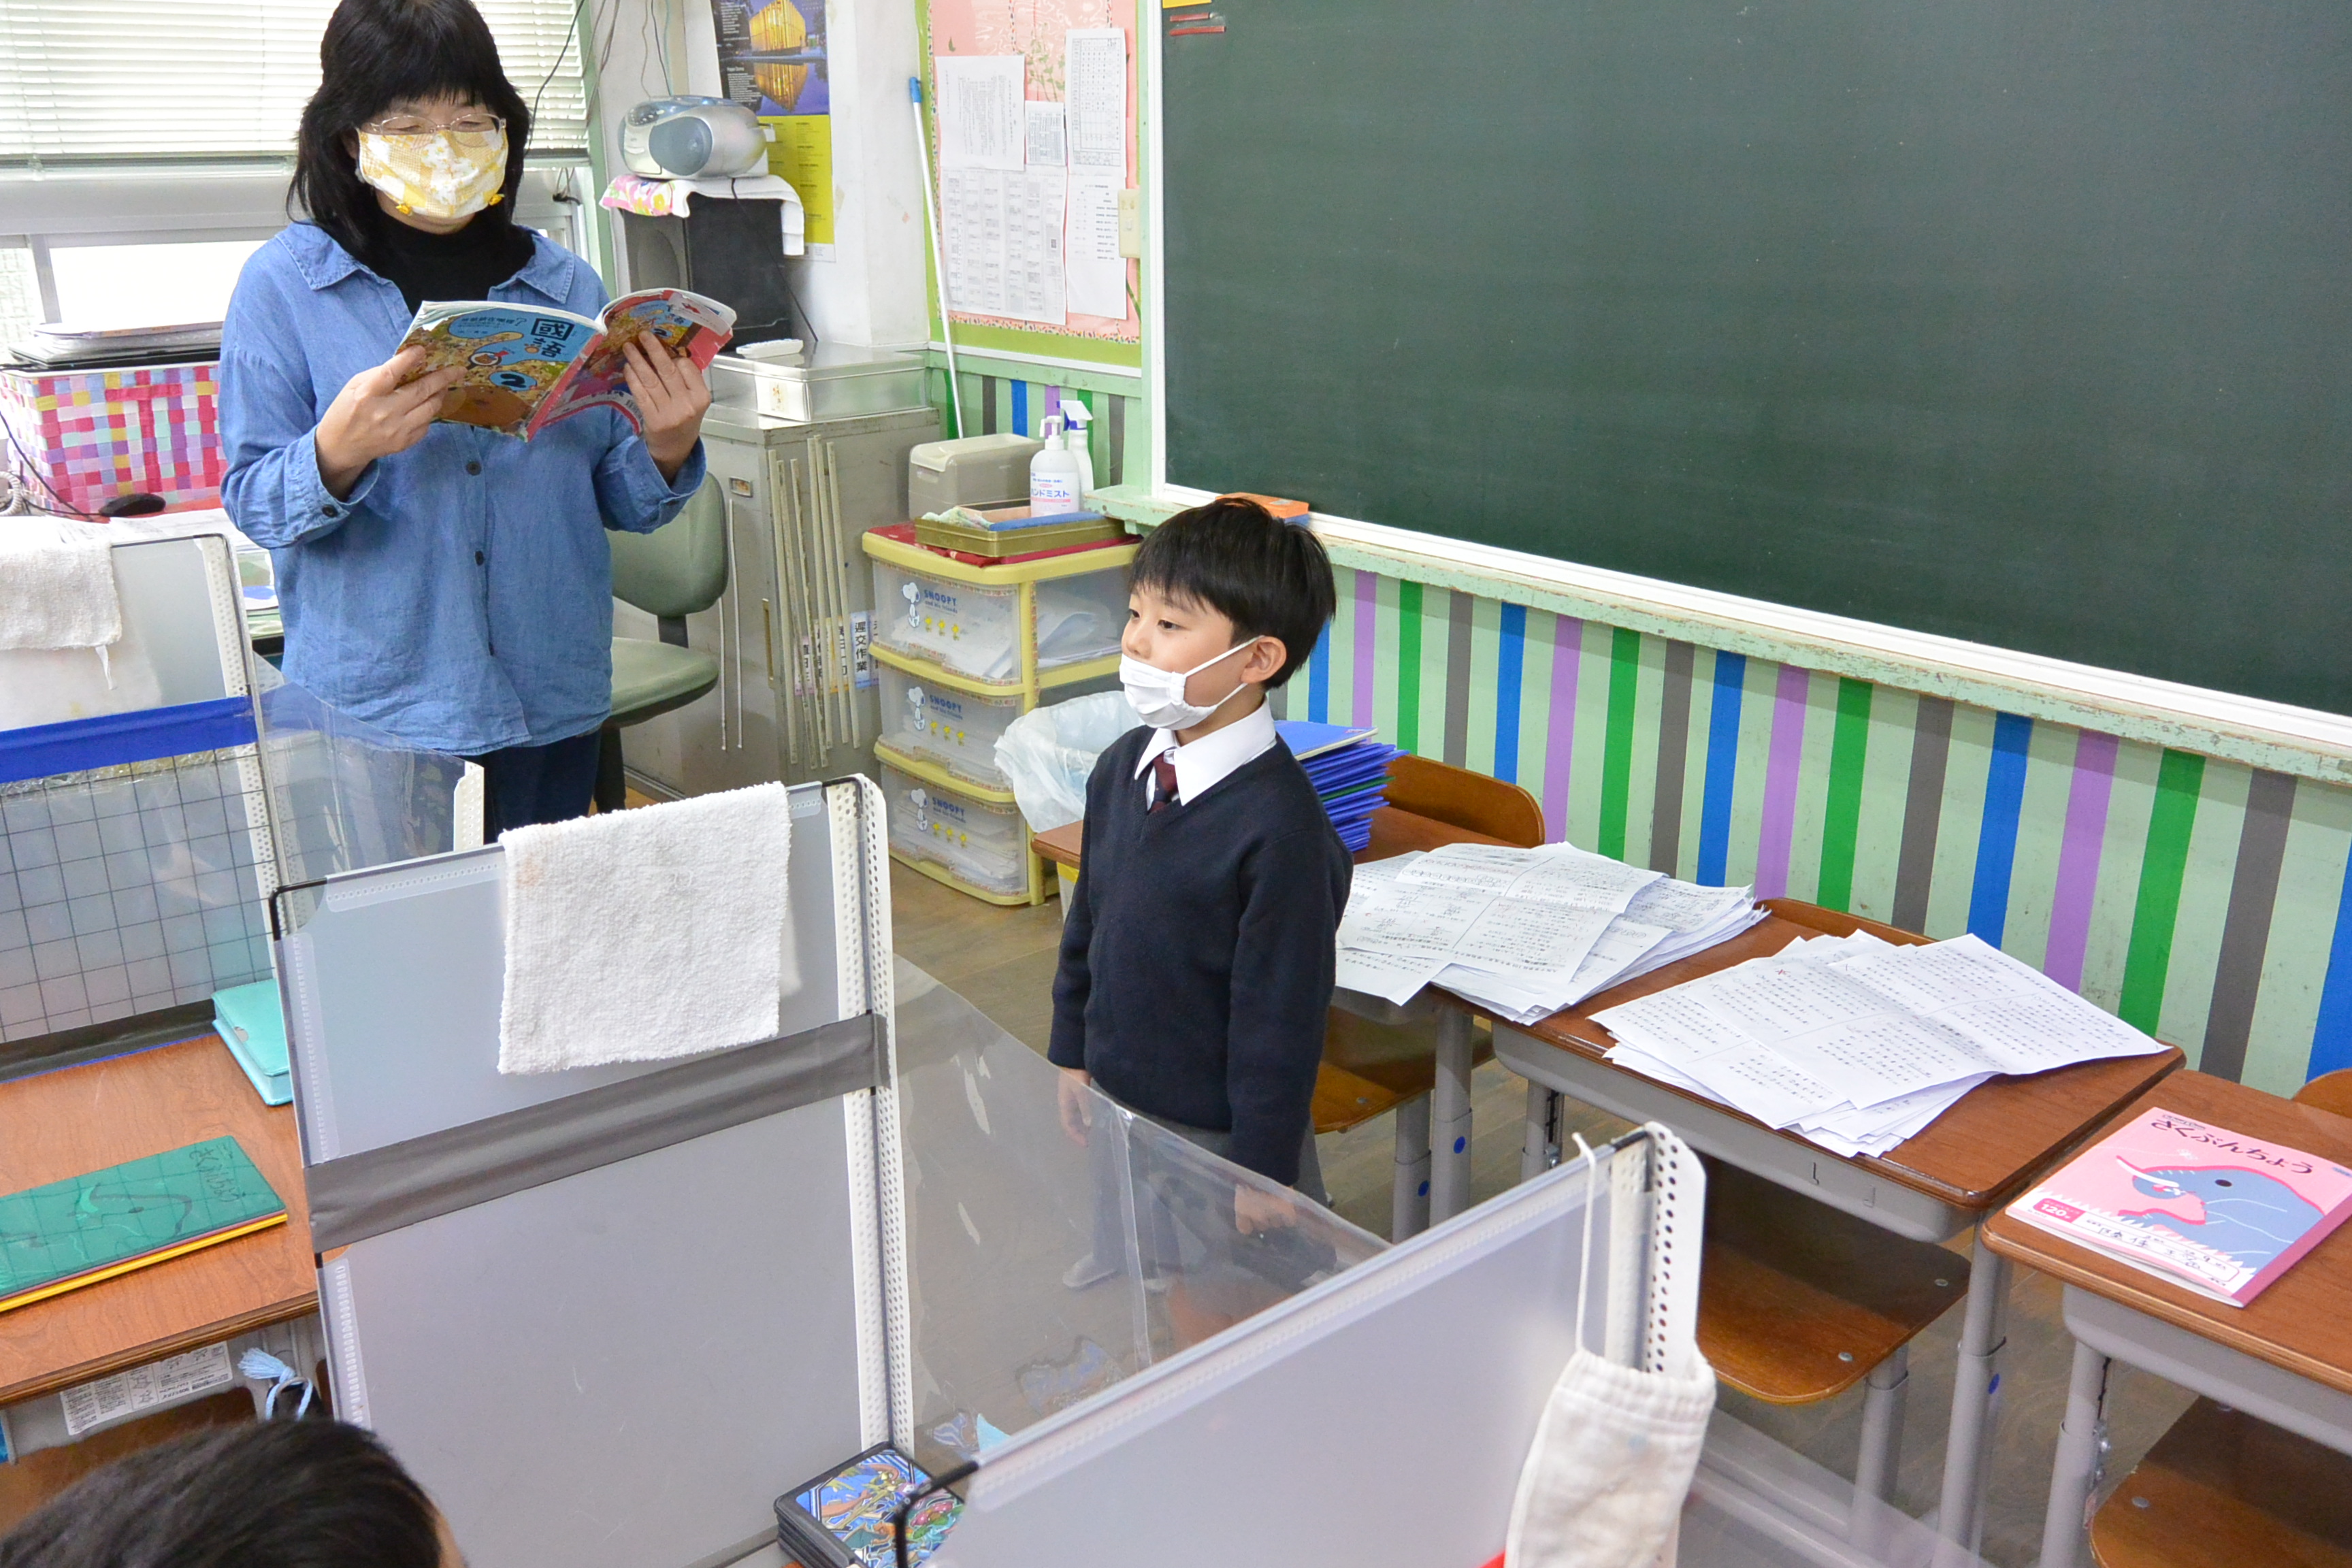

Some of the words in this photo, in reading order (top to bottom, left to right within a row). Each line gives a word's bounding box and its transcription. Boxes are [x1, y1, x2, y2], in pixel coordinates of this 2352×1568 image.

[531, 318, 575, 358] 國語
[500, 373, 527, 388] 2
[1031, 488, 1070, 498] ンドミスト
[924, 589, 956, 606] SNOOPY
[855, 621, 868, 672] 遲交作業
[930, 694, 962, 713] SNOOPY
[932, 797, 964, 816] SNOOPY
[2151, 1120, 2313, 1173] さくぶんちょう
